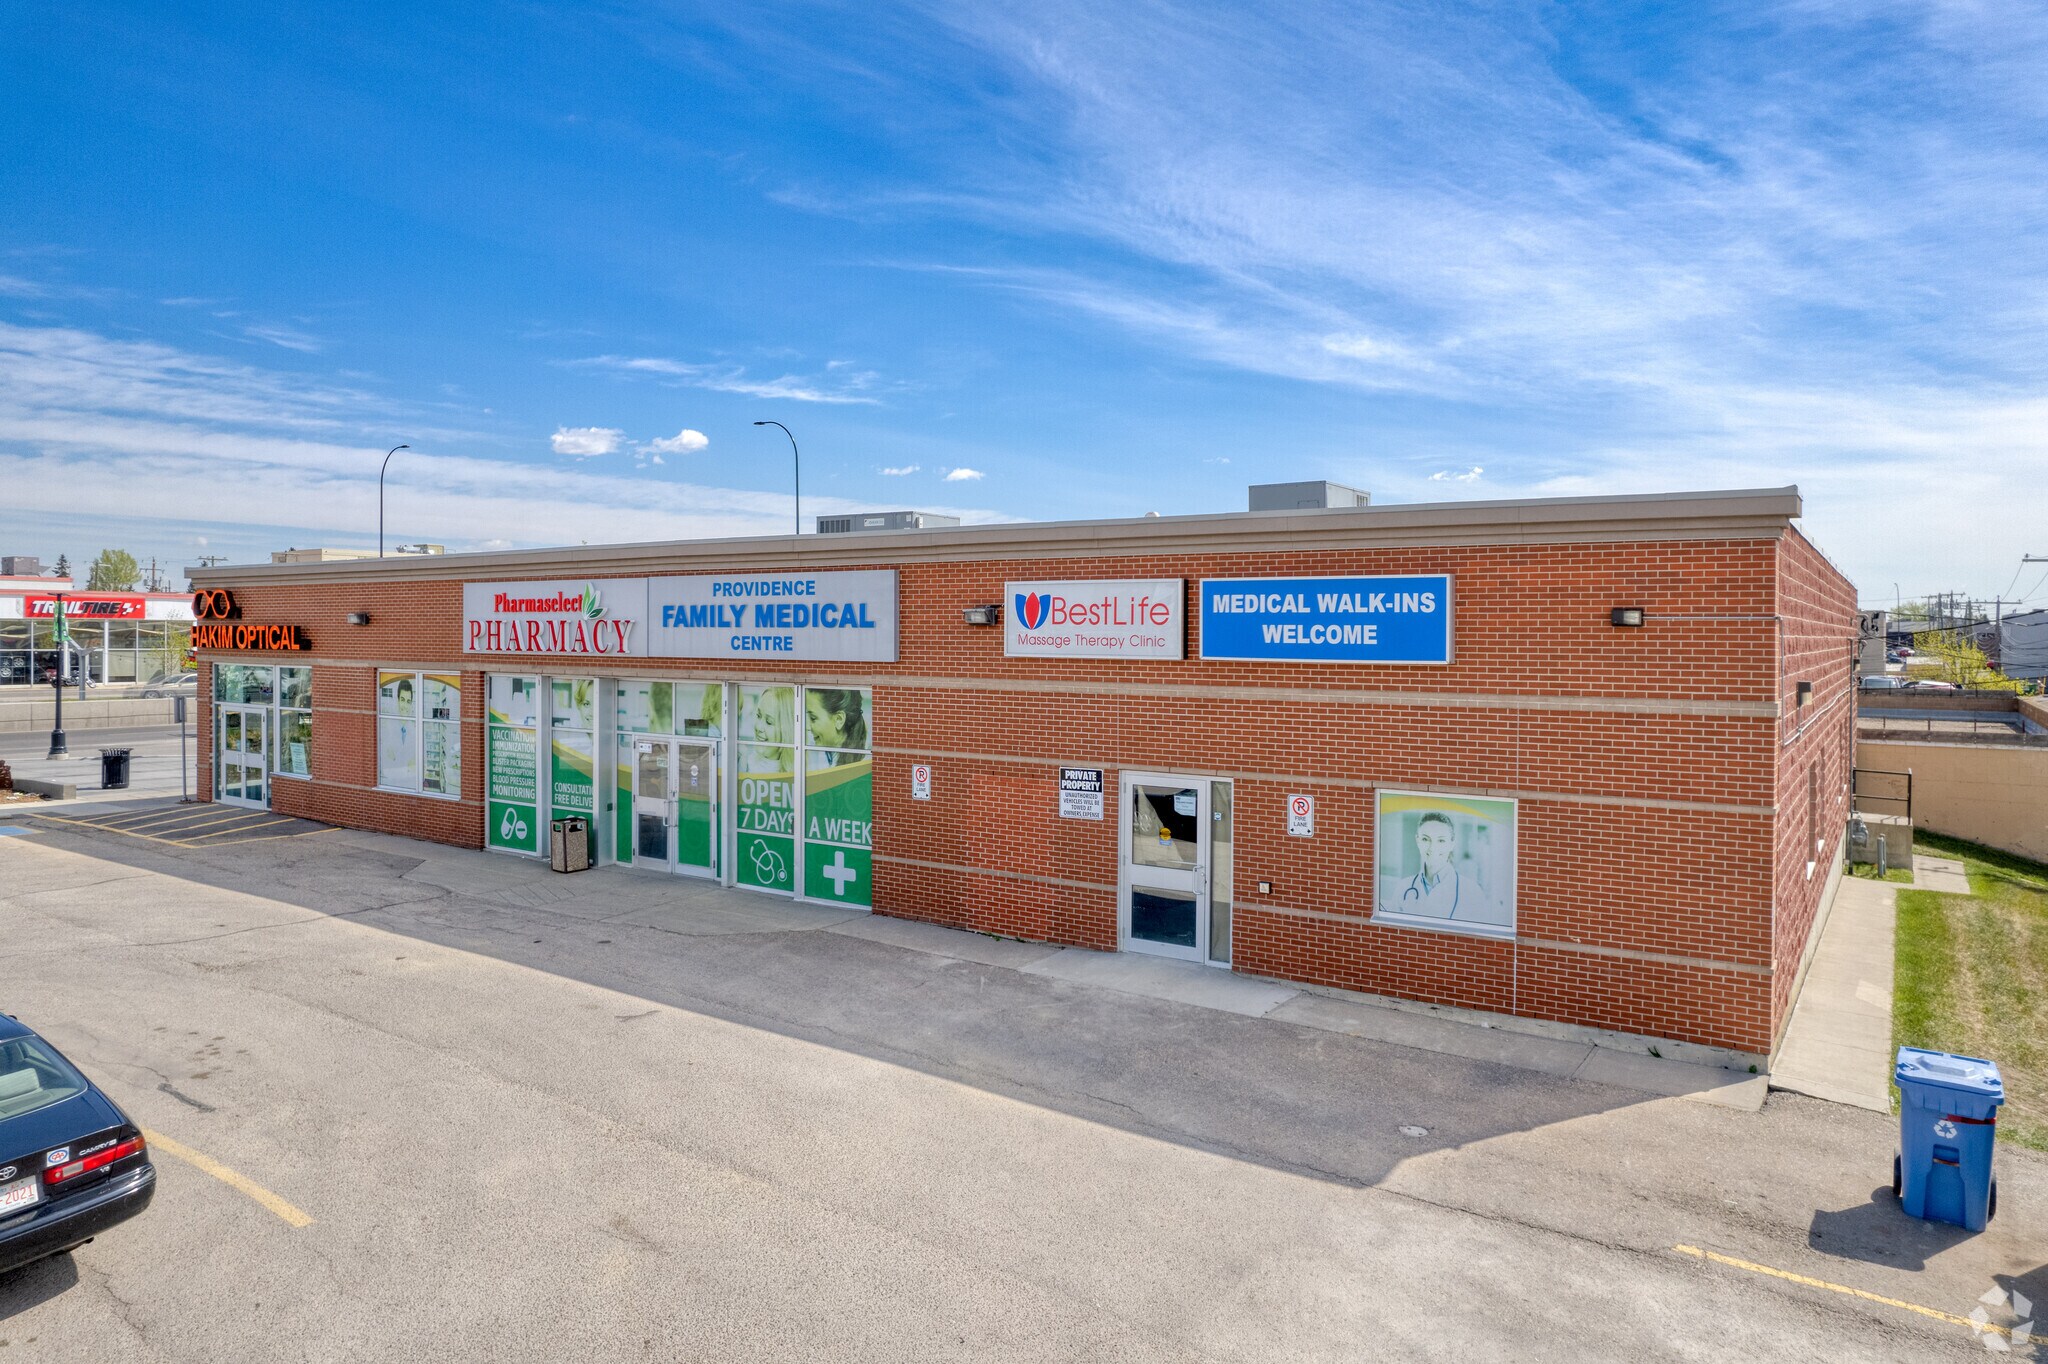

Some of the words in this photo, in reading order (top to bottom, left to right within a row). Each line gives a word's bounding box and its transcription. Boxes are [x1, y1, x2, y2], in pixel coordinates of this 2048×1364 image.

[713, 580, 816, 597] PROVIDENCE
[494, 591, 583, 613] Pharmaselect
[1213, 594, 1310, 613] MEDICAL
[1317, 592, 1436, 613] WALK-INS
[662, 604, 747, 628] FAMILY
[755, 603, 875, 628] MEDICAL
[1051, 596, 1170, 626] BestLife
[191, 624, 233, 648] HAKIM
[236, 624, 300, 650] OPTICAL
[468, 619, 635, 654] PHARMACY
[1017, 633, 1070, 649] Massage
[1075, 633, 1125, 649] Therapy
[1129, 634, 1166, 648] Clinic
[1262, 624, 1378, 645] WELCOME
[730, 635, 793, 651] CENTRE
[492, 730, 535, 742] VACCINATION
[492, 740, 535, 753] IMMUNIZATION
[493, 774, 509, 783] BLOOD
[509, 777, 535, 787] PRESSURE
[1065, 770, 1097, 781] PRIVATE
[492, 784, 535, 798] MONITORING
[741, 778, 794, 809] OPEN
[1061, 780, 1101, 792] PROPERTY
[554, 794, 569, 804] FREE
[1065, 792, 1098, 800] UNAUTHORIZED
[741, 807, 751, 828] 7
[809, 816, 821, 838] A
[824, 818, 872, 845] WEEK
